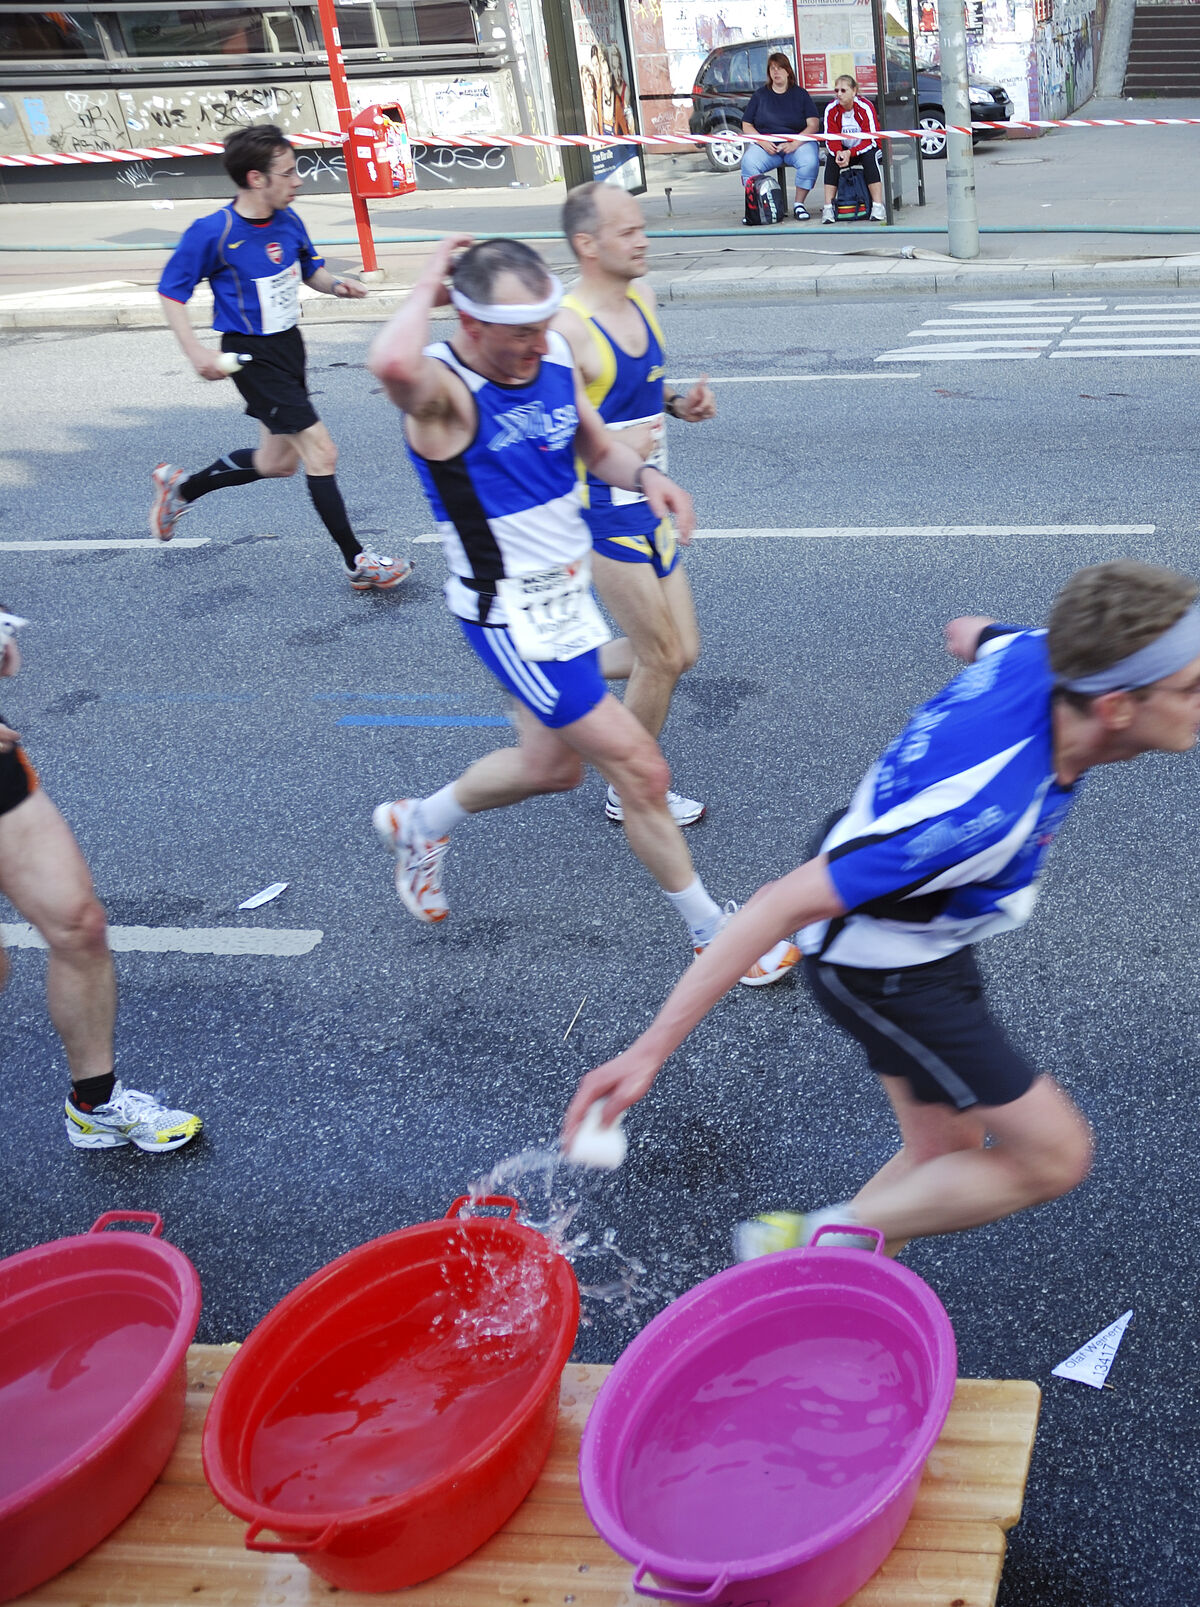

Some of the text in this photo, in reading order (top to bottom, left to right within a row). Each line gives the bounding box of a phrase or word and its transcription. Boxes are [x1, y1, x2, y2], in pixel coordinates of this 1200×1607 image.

[1065, 1325, 1123, 1369] Olaf Weinert
[1093, 1343, 1116, 1376] 13417
